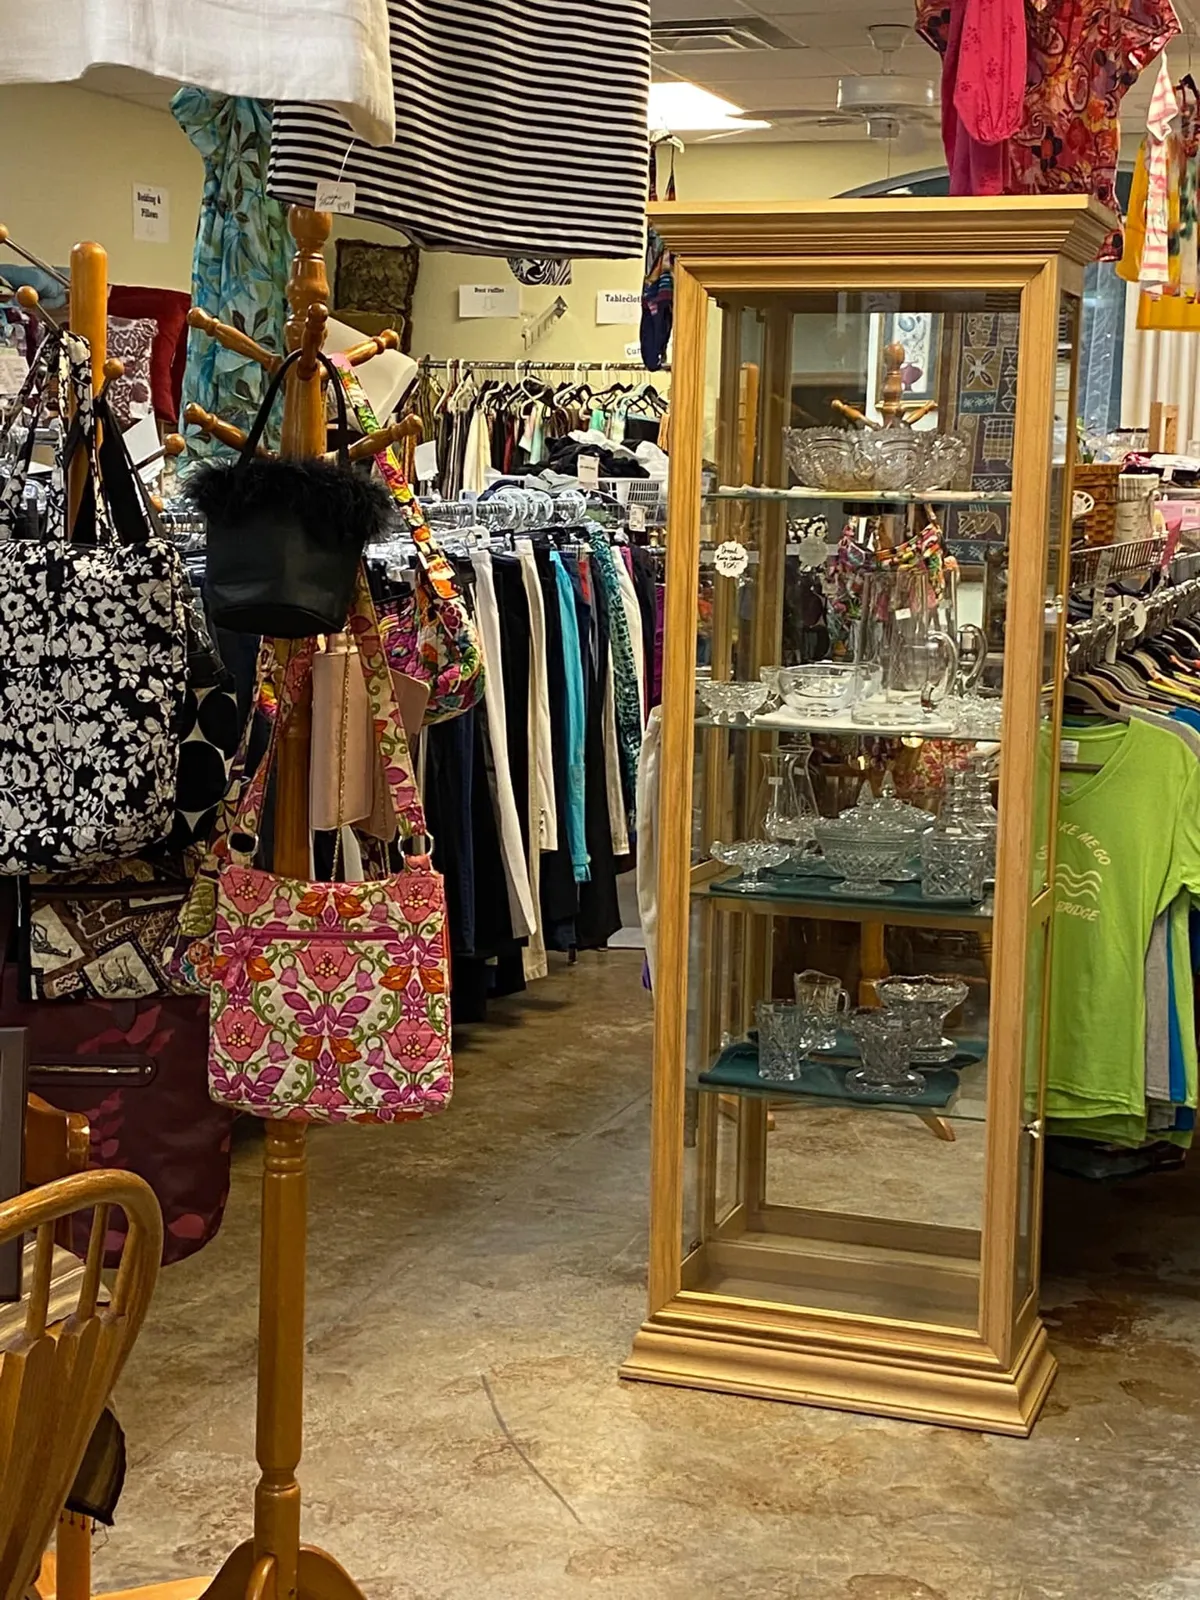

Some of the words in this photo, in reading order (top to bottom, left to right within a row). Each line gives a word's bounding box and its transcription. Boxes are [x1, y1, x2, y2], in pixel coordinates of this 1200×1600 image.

[605, 294, 642, 303] Tableclot
[1076, 832, 1101, 849] ME
[1093, 848, 1112, 866] GO
[1054, 900, 1101, 921] BRIDGE
